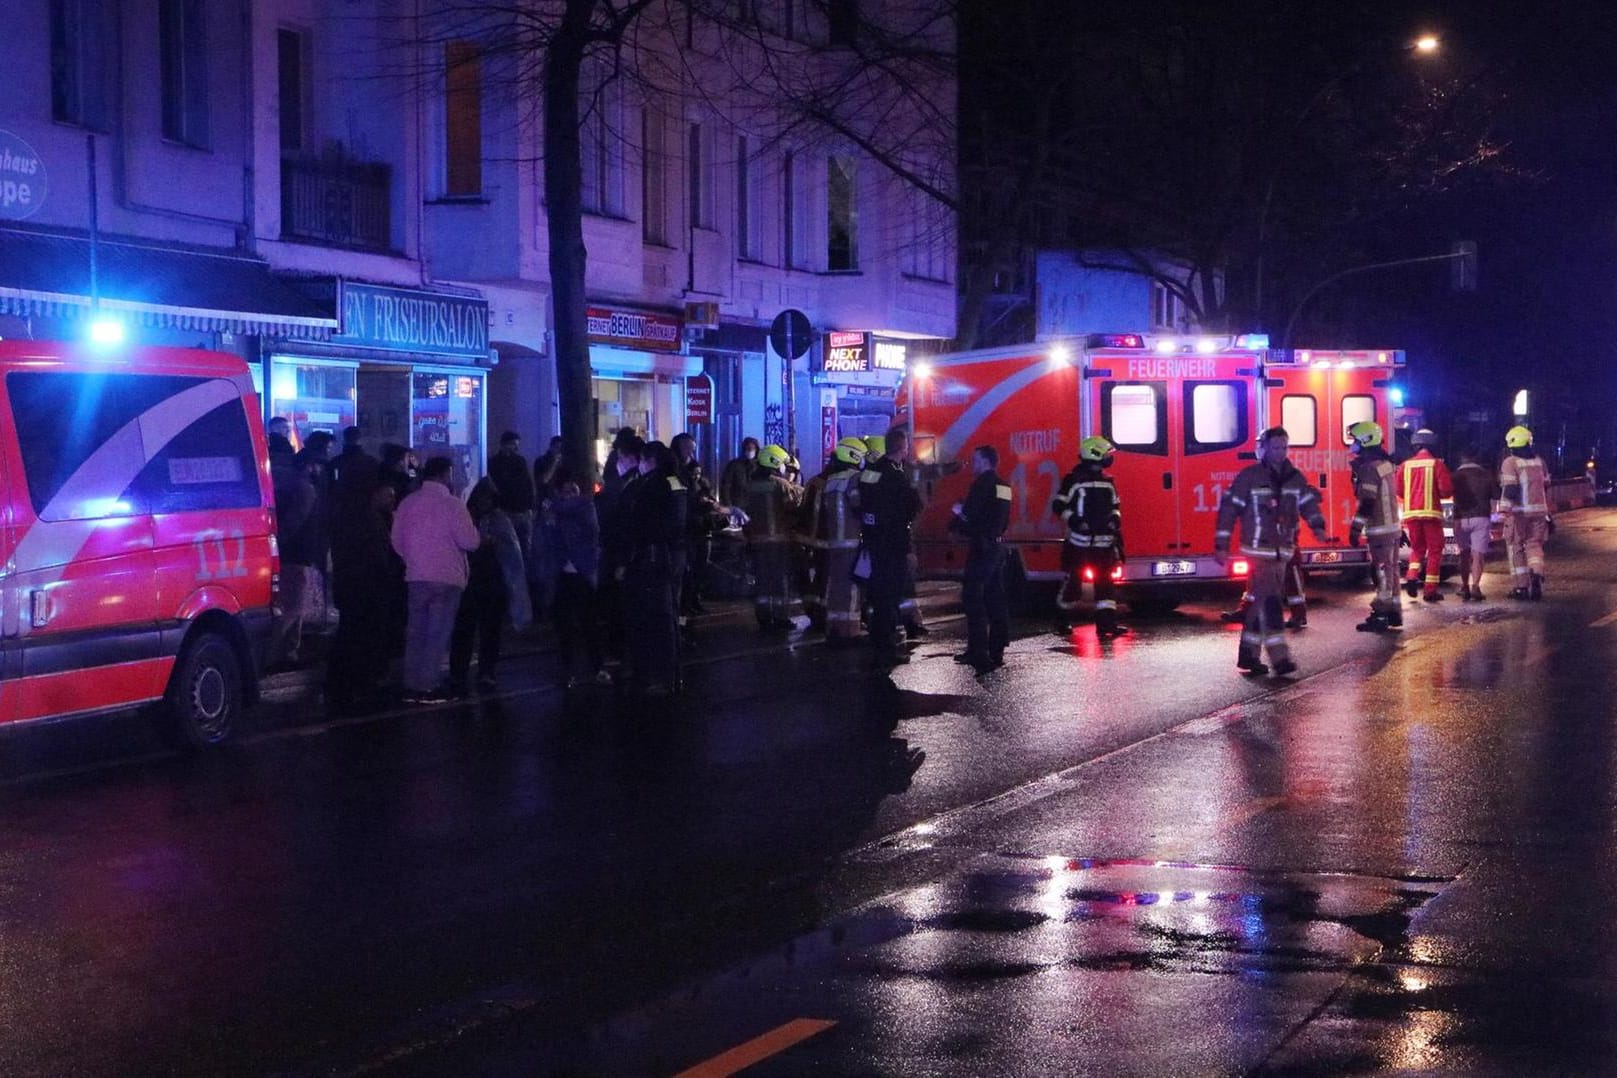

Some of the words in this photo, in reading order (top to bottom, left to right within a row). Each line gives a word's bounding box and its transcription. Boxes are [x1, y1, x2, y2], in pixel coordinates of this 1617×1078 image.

[0, 148, 38, 175] haus
[0, 181, 31, 207] pe
[374, 295, 487, 350] FRISEURSALON
[610, 313, 646, 338] BERLIN
[824, 360, 868, 371] PHONE
[829, 348, 863, 360] NEXT
[1128, 359, 1217, 378] FEUERWEHR
[1010, 428, 1062, 455] NOTRUF
